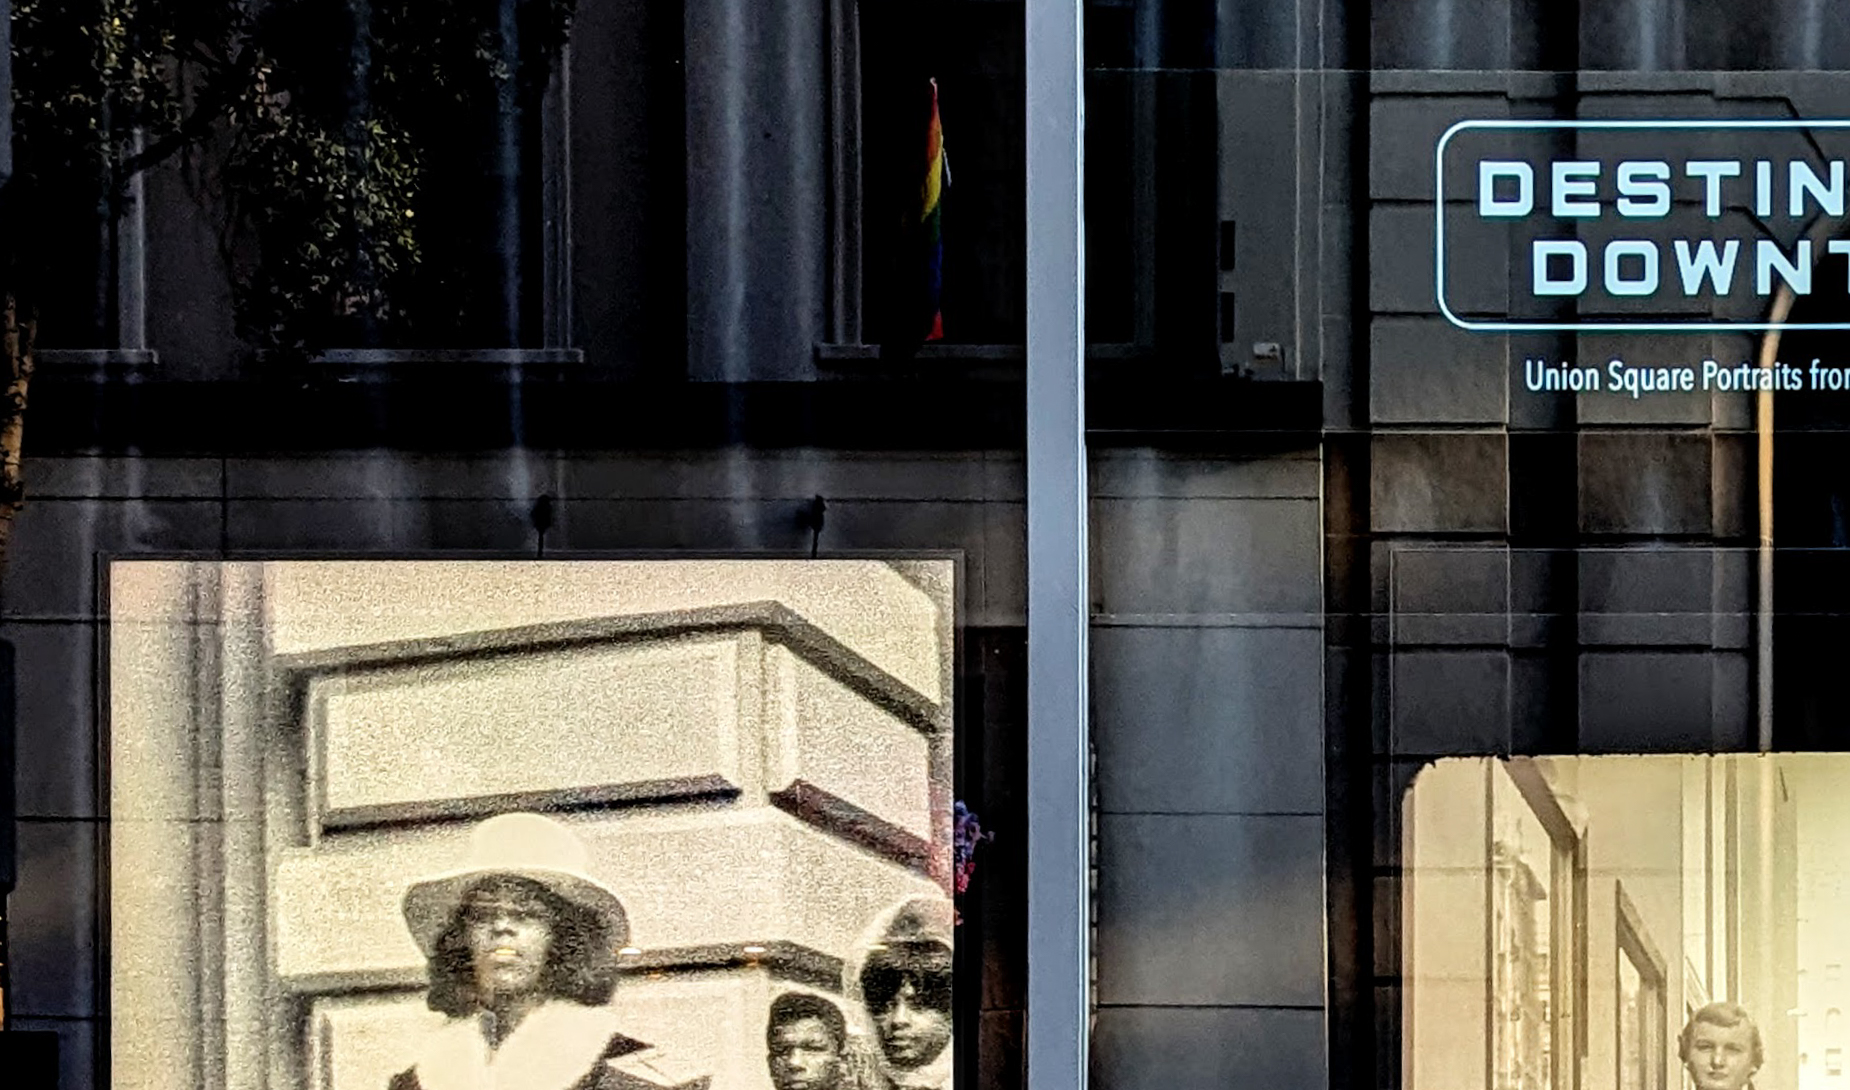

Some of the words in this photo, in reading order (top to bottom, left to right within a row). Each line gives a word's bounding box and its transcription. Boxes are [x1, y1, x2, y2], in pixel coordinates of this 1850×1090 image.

[1525, 359, 1600, 392] Union
[1607, 359, 1695, 400] Square
[1702, 359, 1804, 392] Portraits
